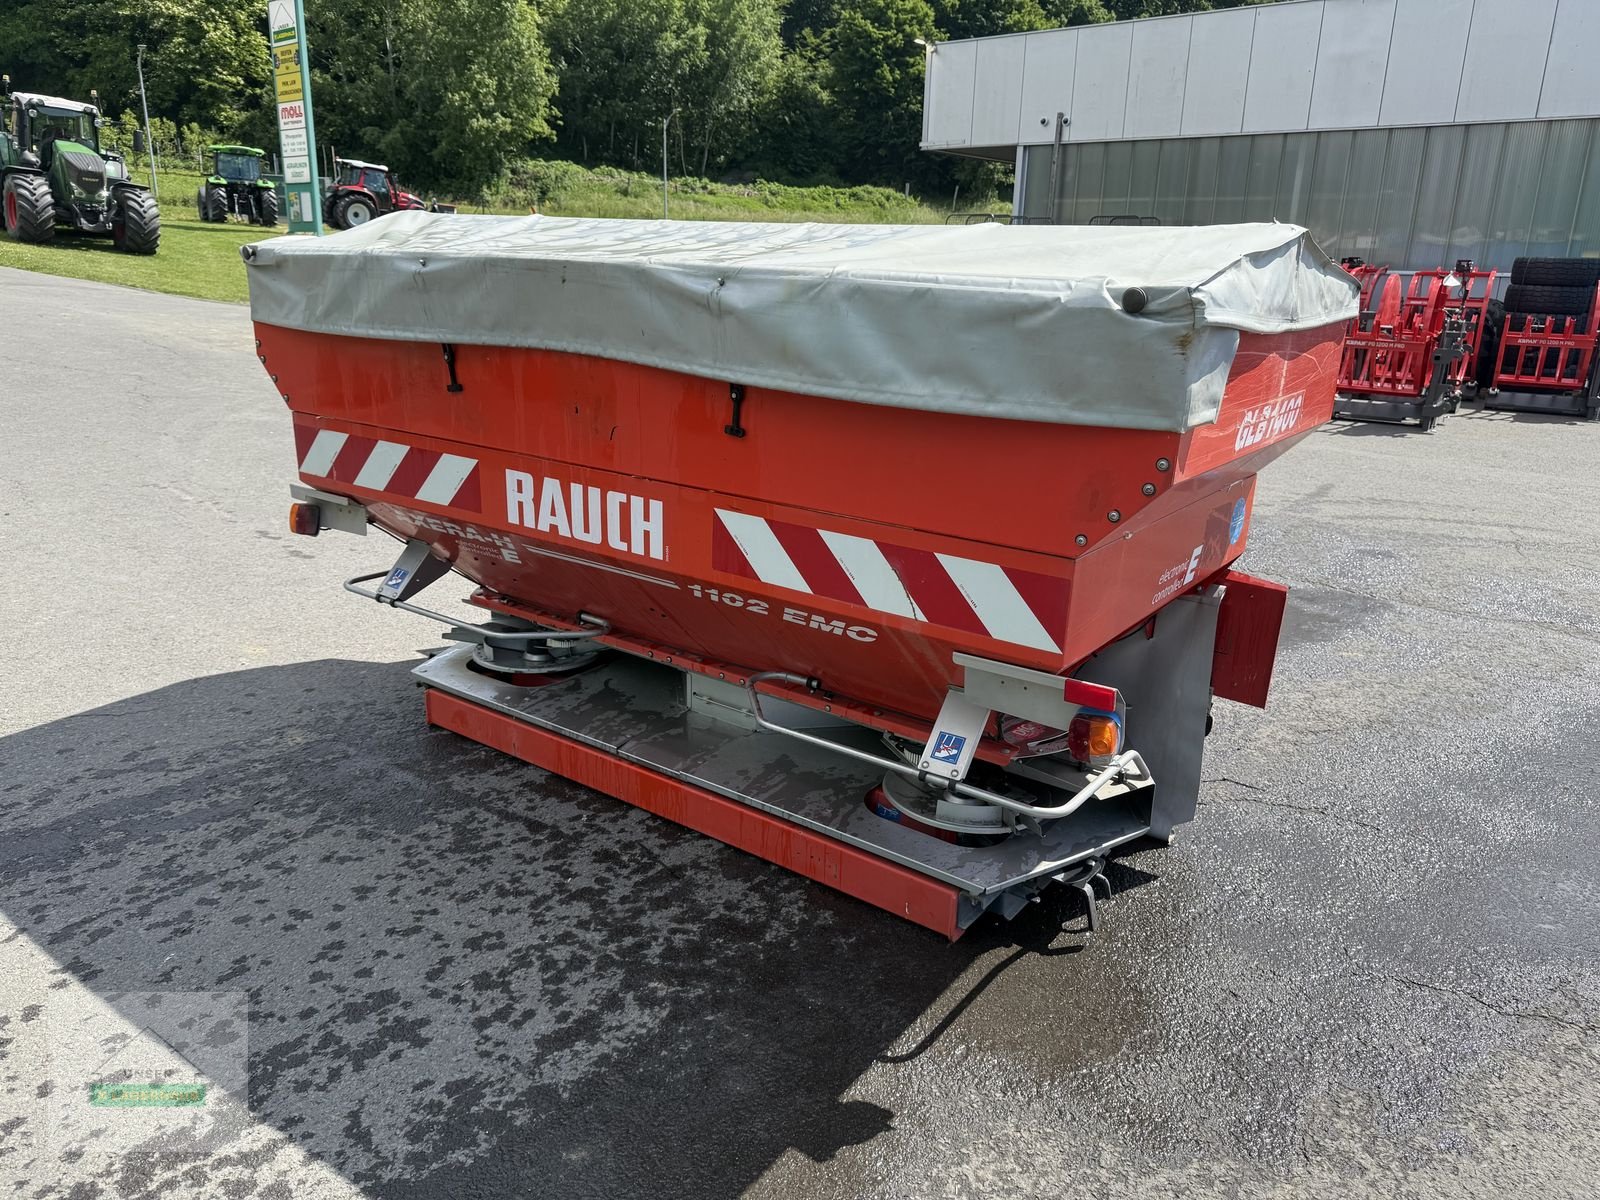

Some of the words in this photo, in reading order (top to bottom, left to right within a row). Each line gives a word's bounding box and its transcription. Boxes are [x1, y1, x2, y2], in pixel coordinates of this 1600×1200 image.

[281, 105, 303, 119] MOLL
[505, 468, 664, 560] RAUCH
[500, 548, 522, 564] E
[1183, 544, 1203, 586] E
[688, 584, 769, 615] 1102
[783, 607, 878, 643] EMC
